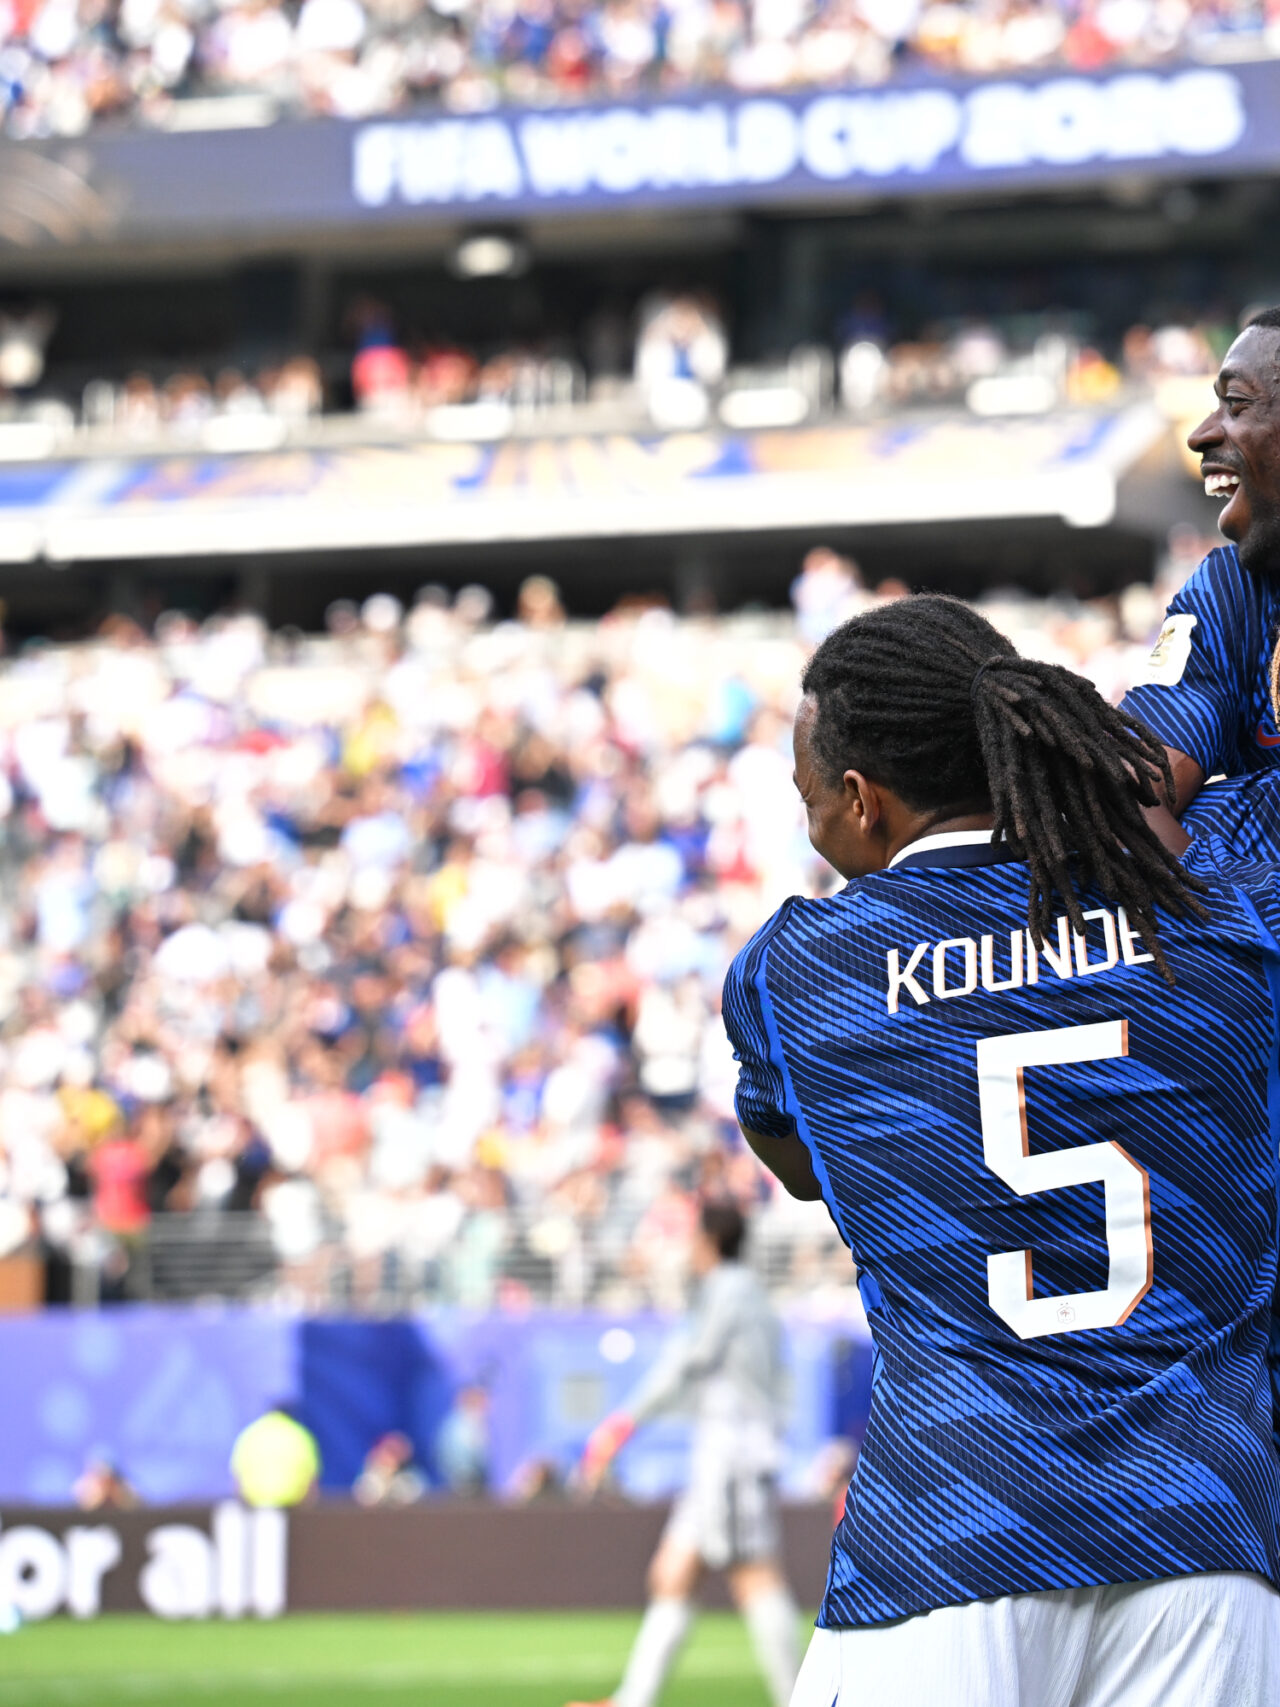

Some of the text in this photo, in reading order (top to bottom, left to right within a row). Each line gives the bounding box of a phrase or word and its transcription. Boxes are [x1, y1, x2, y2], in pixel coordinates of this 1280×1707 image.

[521, 99, 798, 195] WORLD
[802, 88, 959, 180] CUP
[976, 1019, 1153, 1340] 5
[139, 1499, 288, 1619] all
